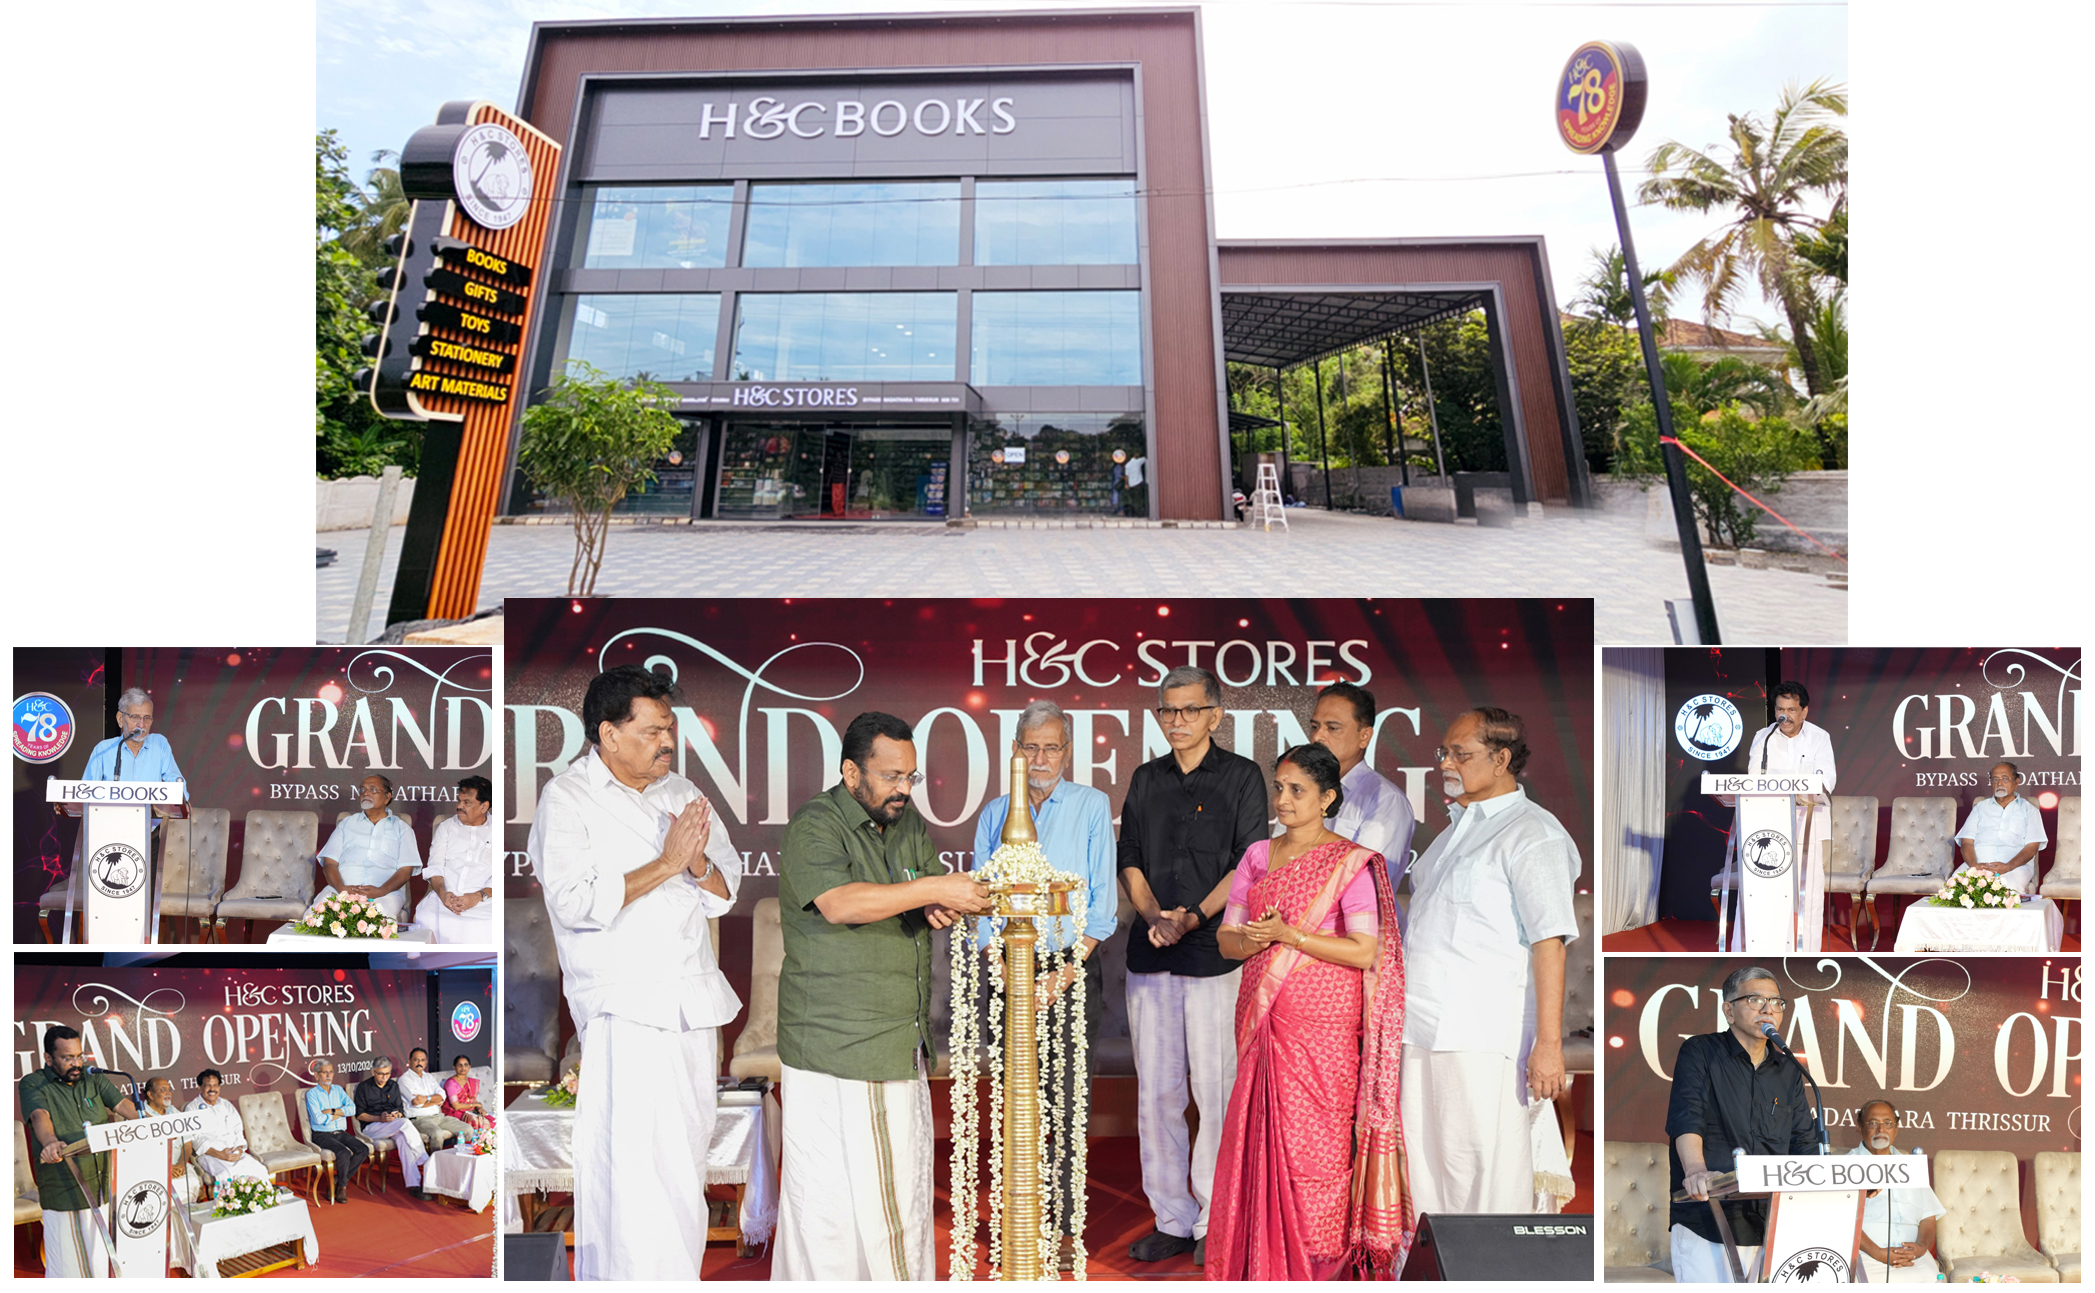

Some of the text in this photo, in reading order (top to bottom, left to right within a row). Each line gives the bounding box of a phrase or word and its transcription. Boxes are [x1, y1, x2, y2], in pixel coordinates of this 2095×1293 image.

[1567, 68, 1606, 125] 78
[699, 97, 1016, 140] H&C BOOKS
[498, 132, 528, 173] STORES
[465, 193, 490, 220] SINCE
[466, 248, 507, 275] BOOKS
[464, 281, 498, 303] GIFTS
[461, 312, 491, 333] TOYS
[430, 340, 504, 369] STATIONERY
[410, 372, 507, 401] ART MATERIALS
[733, 385, 857, 407] H&C STORES
[971, 631, 1372, 688] H&C STORES
[26, 699, 52, 712] H&C
[1702, 696, 1736, 716] STORES
[21, 713, 57, 742] 78
[246, 696, 492, 769] GRAND
[13, 731, 68, 757] SPREADING KNOWLEDGE
[1688, 746, 1730, 759] SINCE 1947
[1715, 777, 1809, 792] H&C BOOKS
[1915, 772, 2081, 787] BYPASS DATHA
[62, 783, 168, 801] H&C BOOKS
[270, 784, 339, 800] BYPASS
[1762, 832, 1787, 846] STORES
[112, 847, 139, 862] STORES
[1754, 867, 1770, 876] SINCE
[101, 886, 120, 895] SINCE
[224, 982, 355, 1006] H&C STORES
[459, 1013, 475, 1030] 78
[203, 1008, 373, 1066] OPENING
[1638, 982, 1955, 1092] GAND
[181, 1073, 241, 1090] THSUR
[104, 1116, 202, 1146] H&C BOOKS
[1947, 1111, 2051, 1133] THRISSUR
[1762, 1161, 1910, 1187] H&C BOOKS
[139, 1183, 163, 1196] STORES
[1513, 1225, 1587, 1235] BLESSON
[1807, 1252, 1843, 1272] STORES
